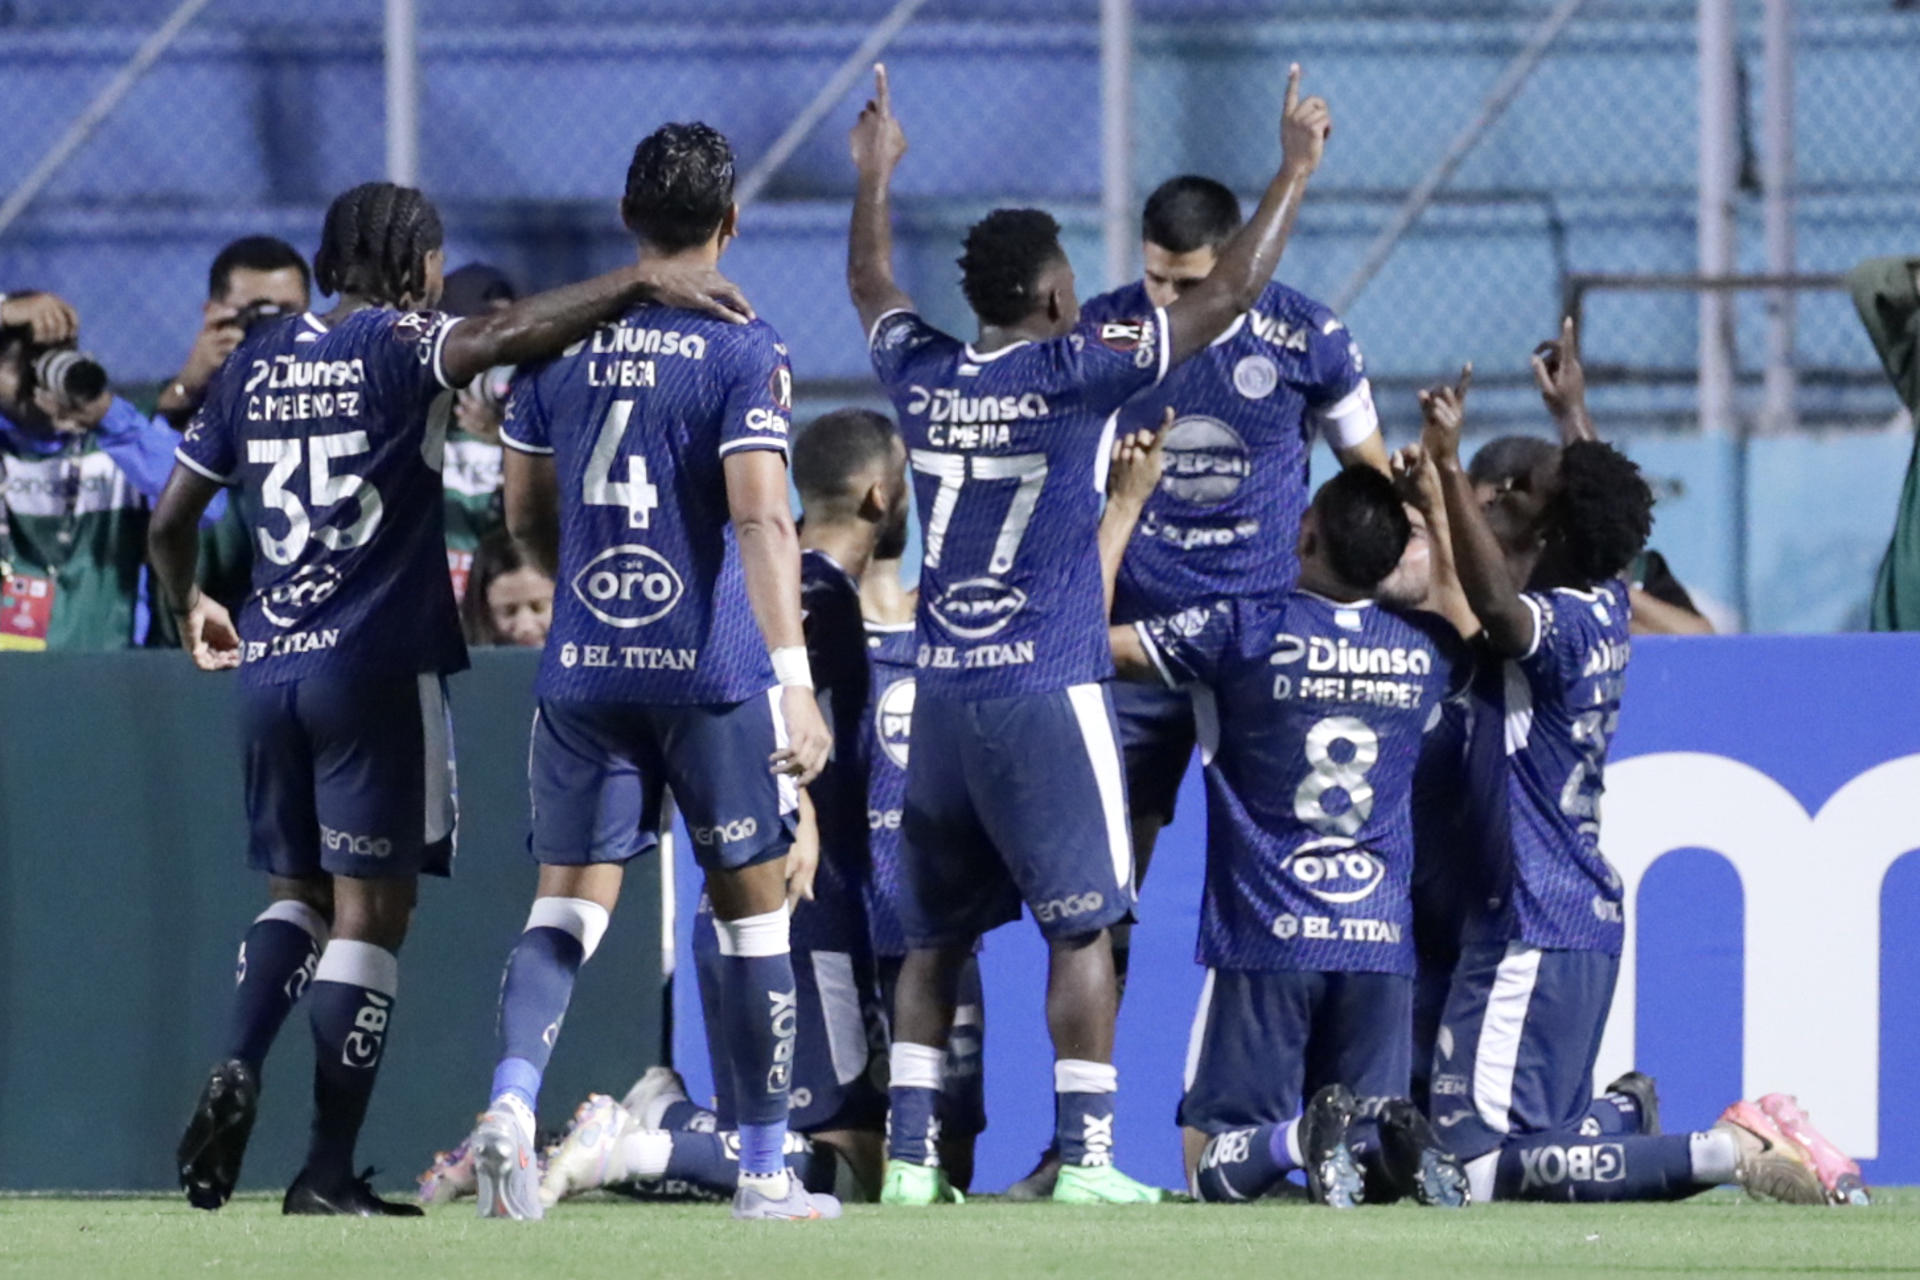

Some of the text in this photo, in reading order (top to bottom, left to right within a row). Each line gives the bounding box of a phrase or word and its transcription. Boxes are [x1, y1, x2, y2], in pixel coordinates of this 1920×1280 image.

[592, 319, 706, 359] Diunsa
[1249, 308, 1307, 353] VISA
[268, 354, 365, 389] Diunsa
[930, 388, 1049, 423] Diunsa
[583, 400, 659, 529] 4
[247, 430, 383, 566] 35
[910, 449, 1049, 575] 77
[588, 571, 672, 602] oro
[582, 645, 618, 667] EL
[621, 646, 698, 671] TITAN
[931, 641, 1035, 669] EL TITAN
[1307, 635, 1431, 676] Diunsa
[1293, 715, 1379, 837] 8
[1292, 851, 1373, 883] oro
[1302, 916, 1339, 939] EL
